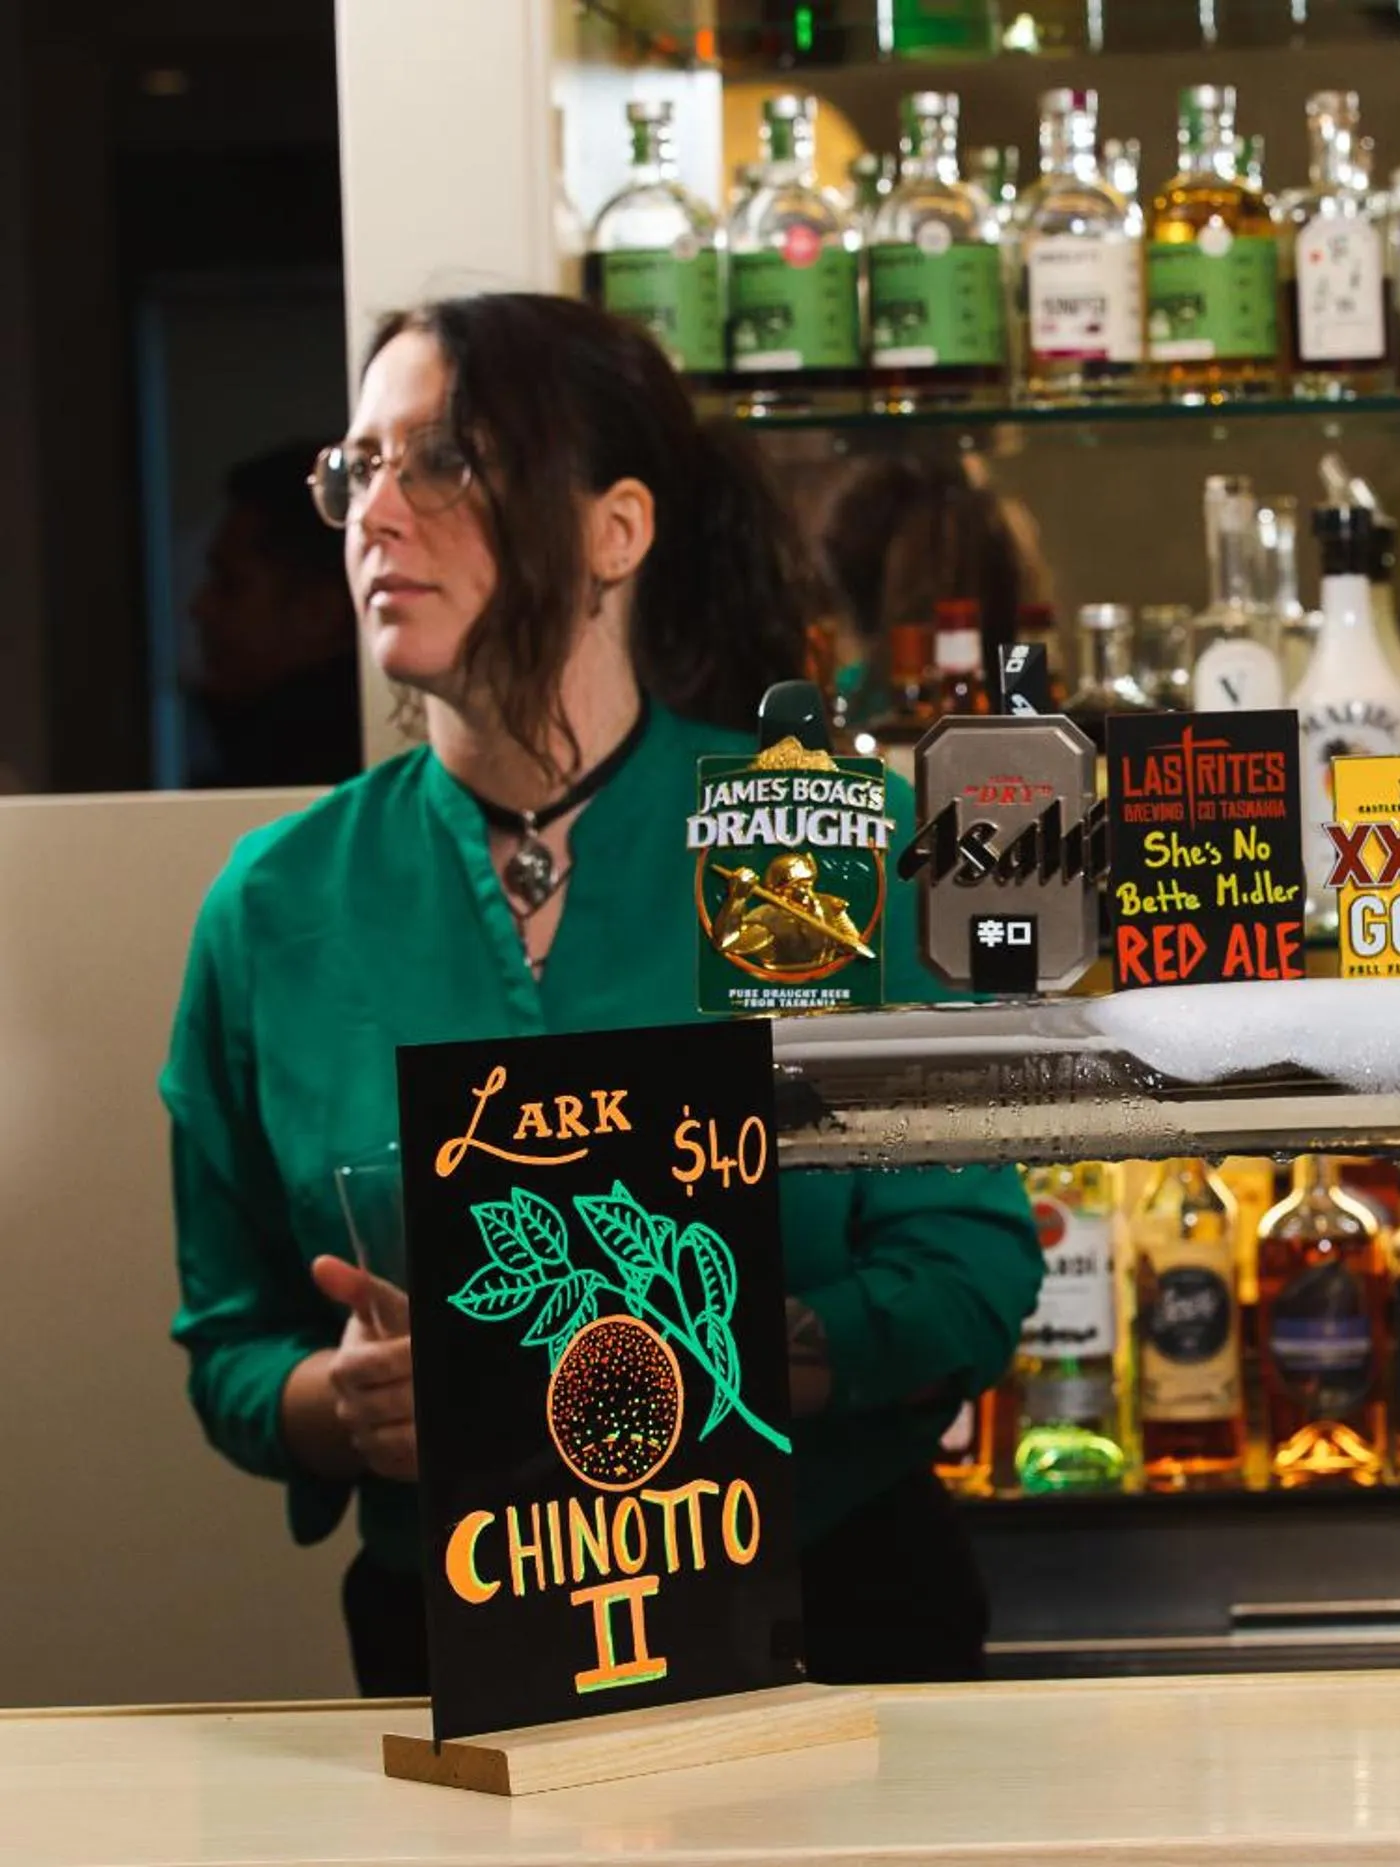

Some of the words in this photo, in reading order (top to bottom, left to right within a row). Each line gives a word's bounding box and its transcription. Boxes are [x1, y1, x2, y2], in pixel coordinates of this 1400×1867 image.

[701, 778, 786, 813] JAMES
[792, 778, 885, 812] BOAG'S
[1197, 751, 1285, 794] RITES
[687, 808, 895, 849] DRAUGHT
[1144, 831, 1221, 868] She's
[1234, 825, 1271, 860] No
[1116, 882, 1200, 917] Bette
[1216, 867, 1299, 908] Midler
[977, 919, 1032, 947] 辛口
[1117, 923, 1208, 986] RED
[1222, 922, 1305, 981] ALE
[729, 989, 759, 998] PURE
[435, 1065, 631, 1177] LARK
[671, 1105, 767, 1197] $40
[445, 1478, 760, 1604] CHINOTTO
[570, 1575, 667, 1694] II
